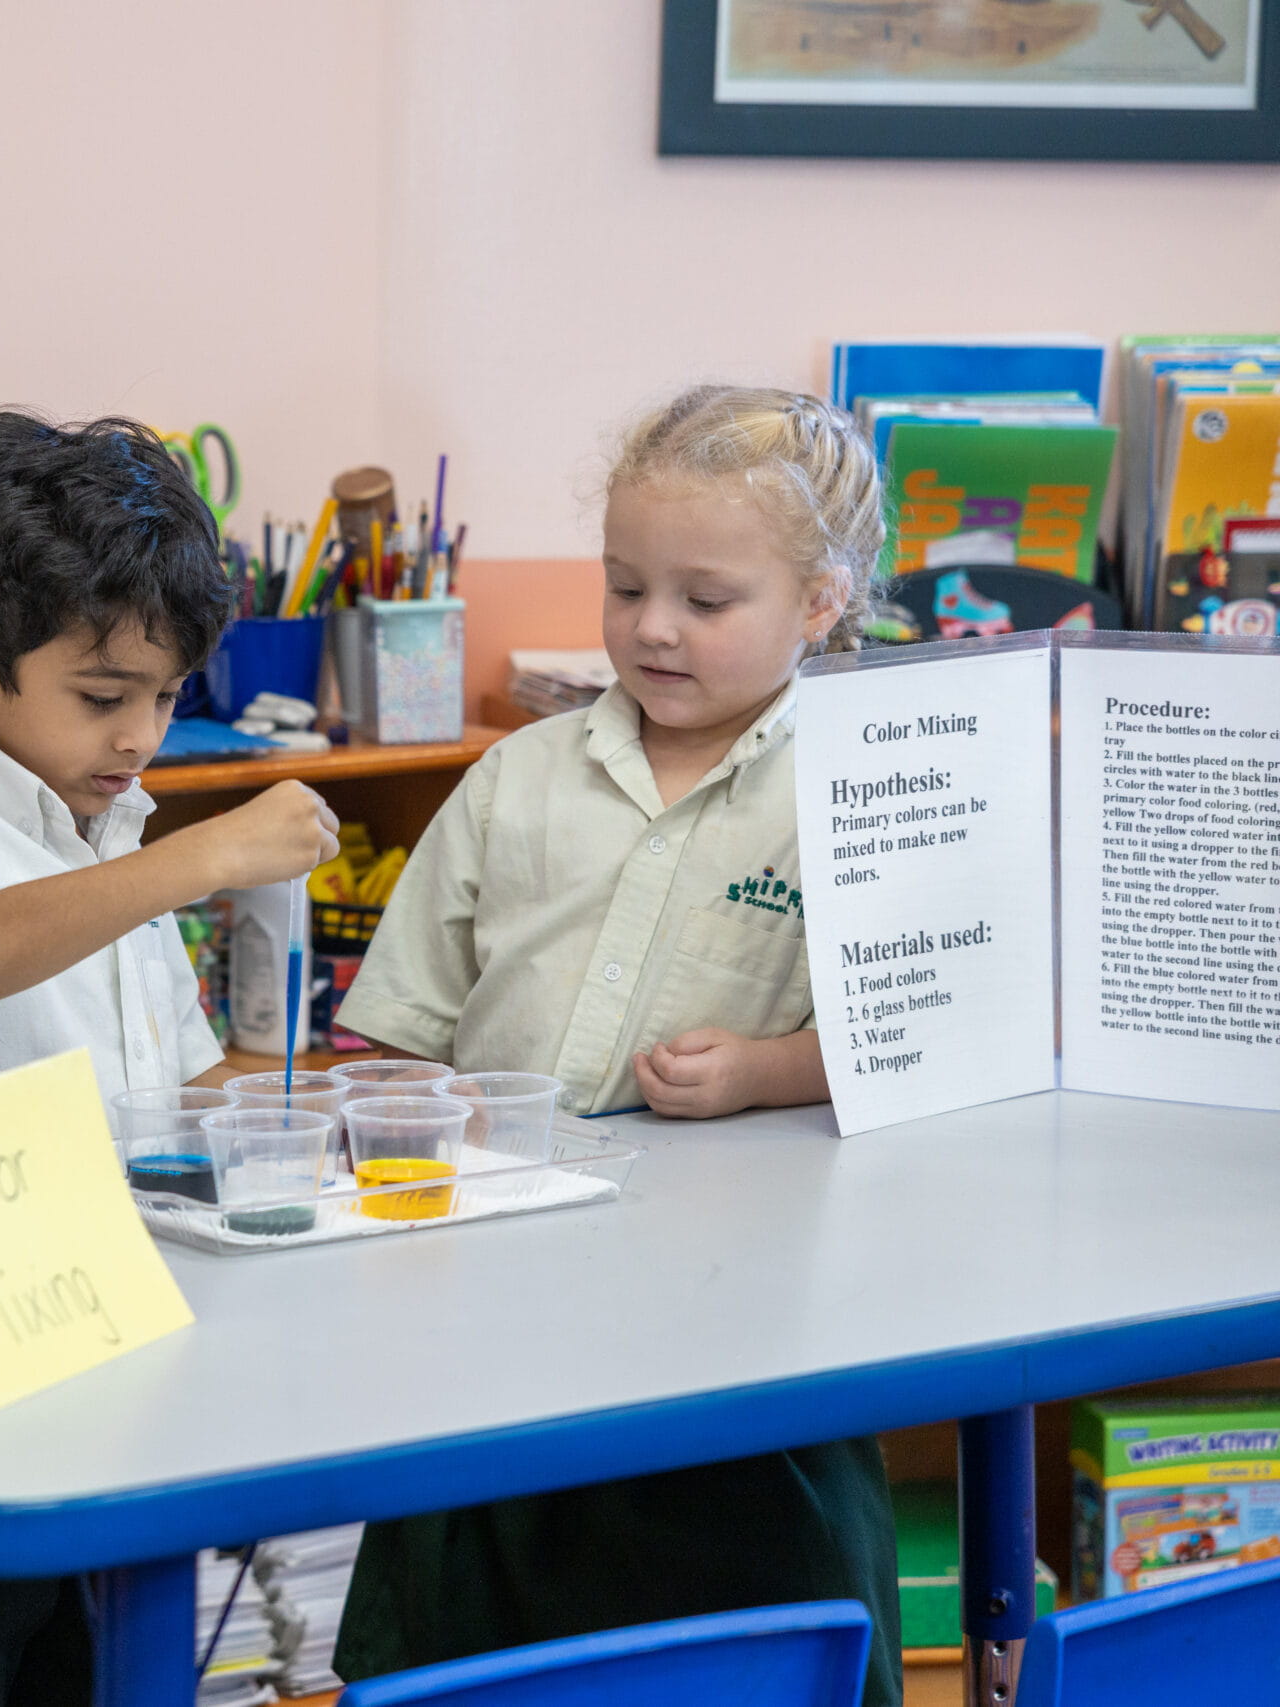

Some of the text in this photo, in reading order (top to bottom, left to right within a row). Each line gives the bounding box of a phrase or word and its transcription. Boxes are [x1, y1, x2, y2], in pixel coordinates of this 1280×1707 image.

[1104, 697, 1211, 720] Procedure:
[863, 713, 977, 744] Color Mixing
[1105, 720, 1267, 738] 1. Place the bottles on the color
[1104, 736, 1125, 747] tray
[1104, 749, 1264, 768] 2. Fill the bottles placed on the
[1103, 763, 1136, 775] circles
[1139, 766, 1162, 776] with
[1165, 768, 1195, 778] water
[1198, 770, 1209, 779] to
[1212, 770, 1228, 780] the
[1231, 771, 1260, 782] black
[831, 767, 952, 809] Hypothesis:
[1103, 777, 1278, 797] 3. Color the water in the 3 bottles
[1103, 792, 1146, 806] primary
[1148, 795, 1176, 806] color
[1178, 797, 1201, 807] food
[1204, 798, 1251, 812] coloring.
[832, 797, 987, 833] Primary colors can be
[1103, 806, 1136, 820] yellow
[1138, 809, 1162, 820] Two
[1164, 811, 1194, 824] drops
[1197, 813, 1209, 823] of
[1211, 814, 1234, 824] food
[1102, 820, 1263, 840] 4. Fill the yellow colored water
[833, 829, 966, 860] mixed to make new
[1102, 835, 1268, 855] next to it using a dropper to the
[1102, 848, 1268, 870] Then fill the water from the red
[834, 867, 880, 886] colors.
[1102, 862, 1280, 885] the bottle with the yellow water to
[1102, 876, 1219, 897] line using the dropper.
[744, 896, 788, 914] SCHOOL
[1102, 890, 1275, 913] 5. Fill the red colored water from
[1102, 920, 1275, 944] using the dropper. Then pour the
[840, 920, 992, 968] Materials used:
[1101, 933, 1277, 957] the blue bottle into the bottle with
[844, 967, 936, 996] 1. Food colors
[1101, 961, 1278, 986] 6. Fill the blue colored water from
[847, 990, 952, 1023] 2. 6 glass bottles
[1101, 990, 1262, 1014] using the dropper. Then fill the
[1101, 1004, 1260, 1029] the yellow bottle into the bottle
[850, 1027, 906, 1050] 3. Water
[855, 1051, 923, 1075] 4. Dropper
[1128, 1431, 1280, 1462] WRITING ACTIVITY
